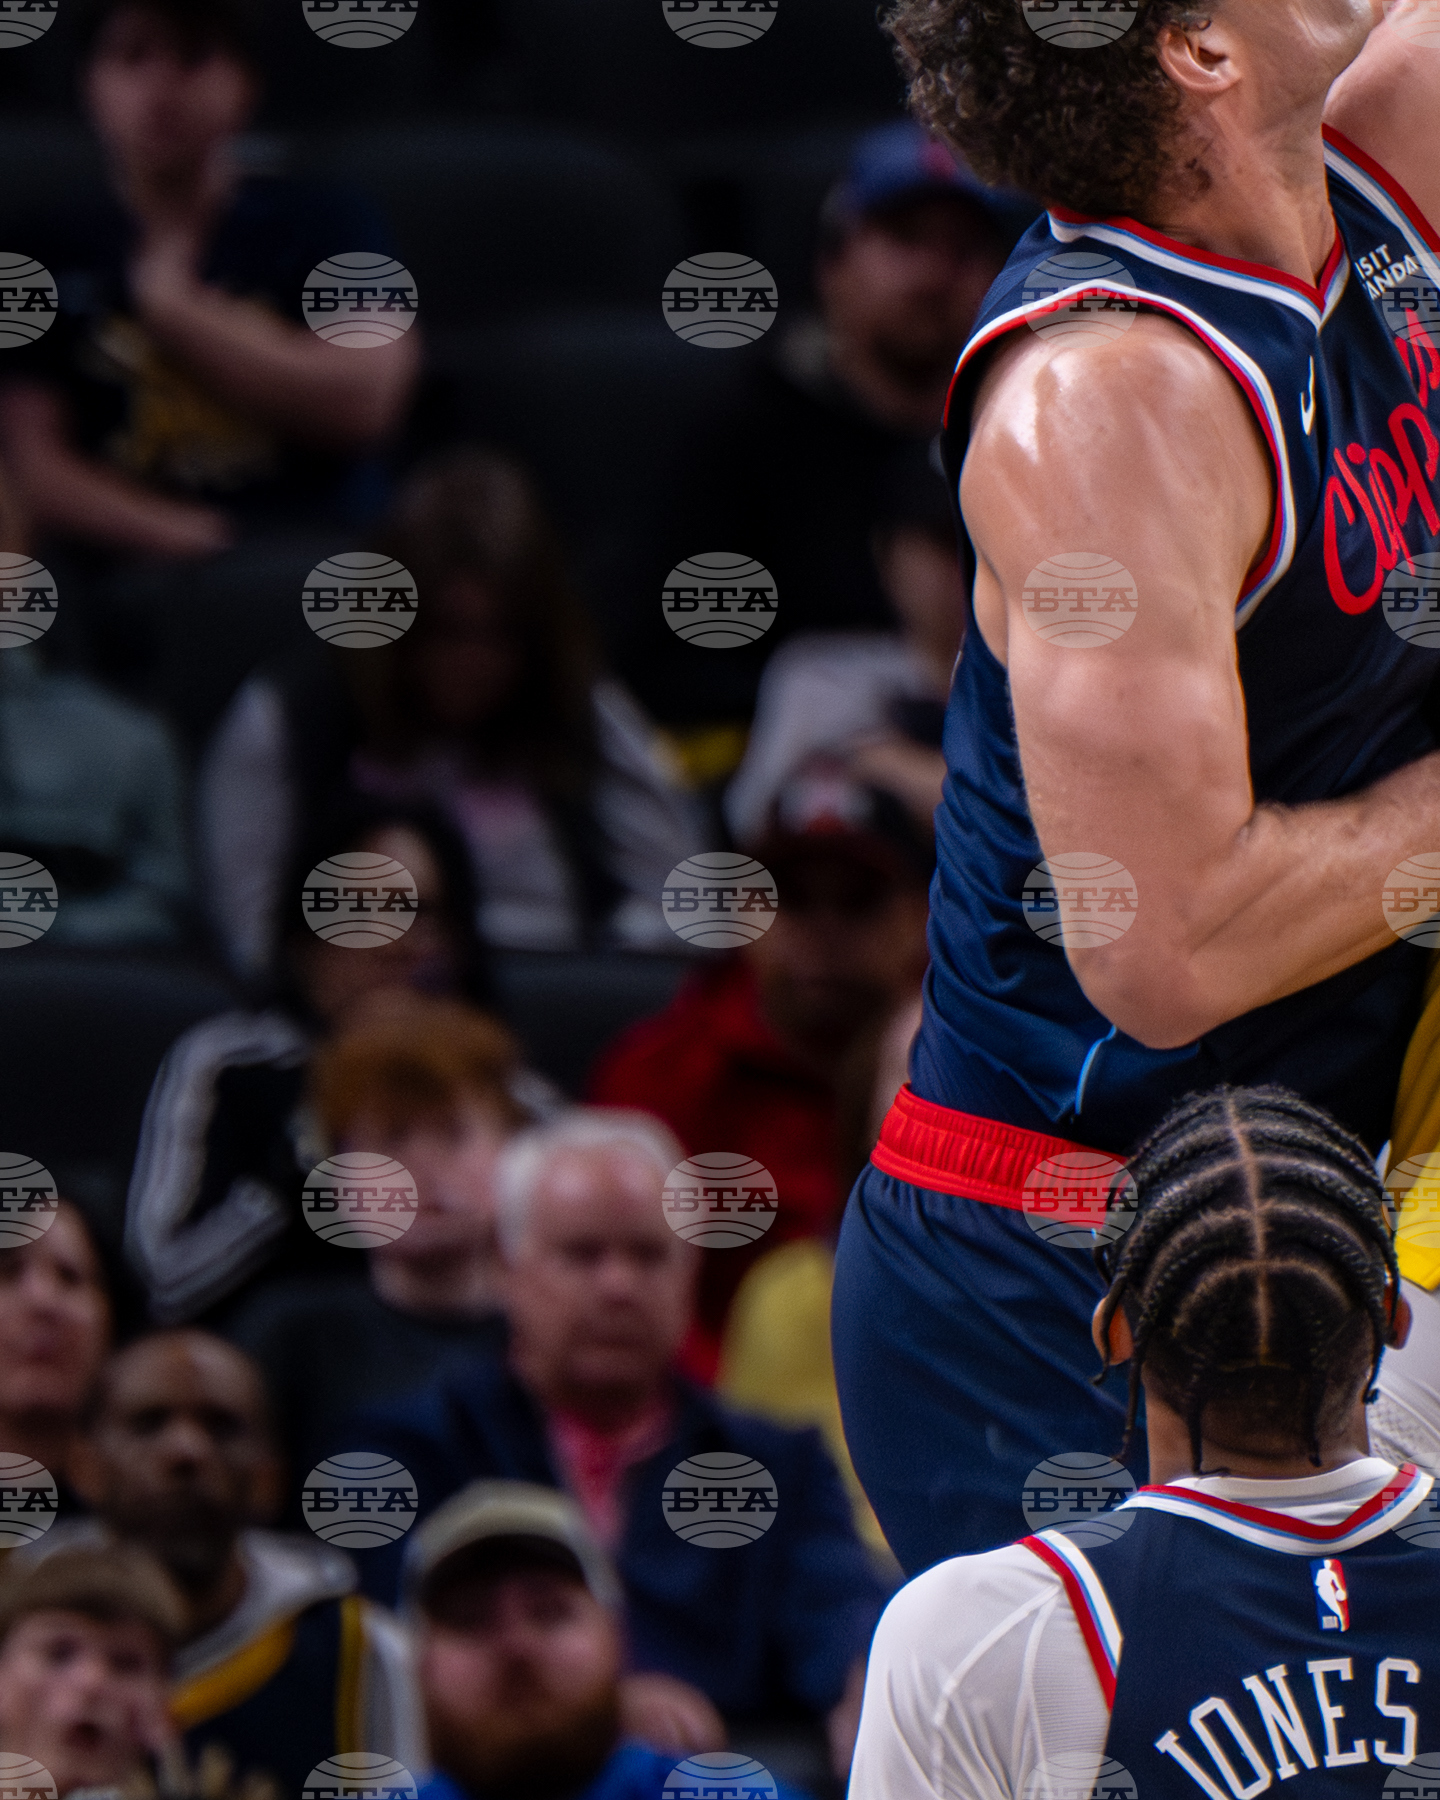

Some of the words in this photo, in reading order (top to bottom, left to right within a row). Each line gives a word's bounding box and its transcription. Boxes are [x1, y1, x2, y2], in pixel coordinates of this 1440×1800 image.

[1353, 243, 1392, 280] ISIT
[1362, 254, 1419, 300] ANDA
[1154, 1657, 1421, 1800] JONES
